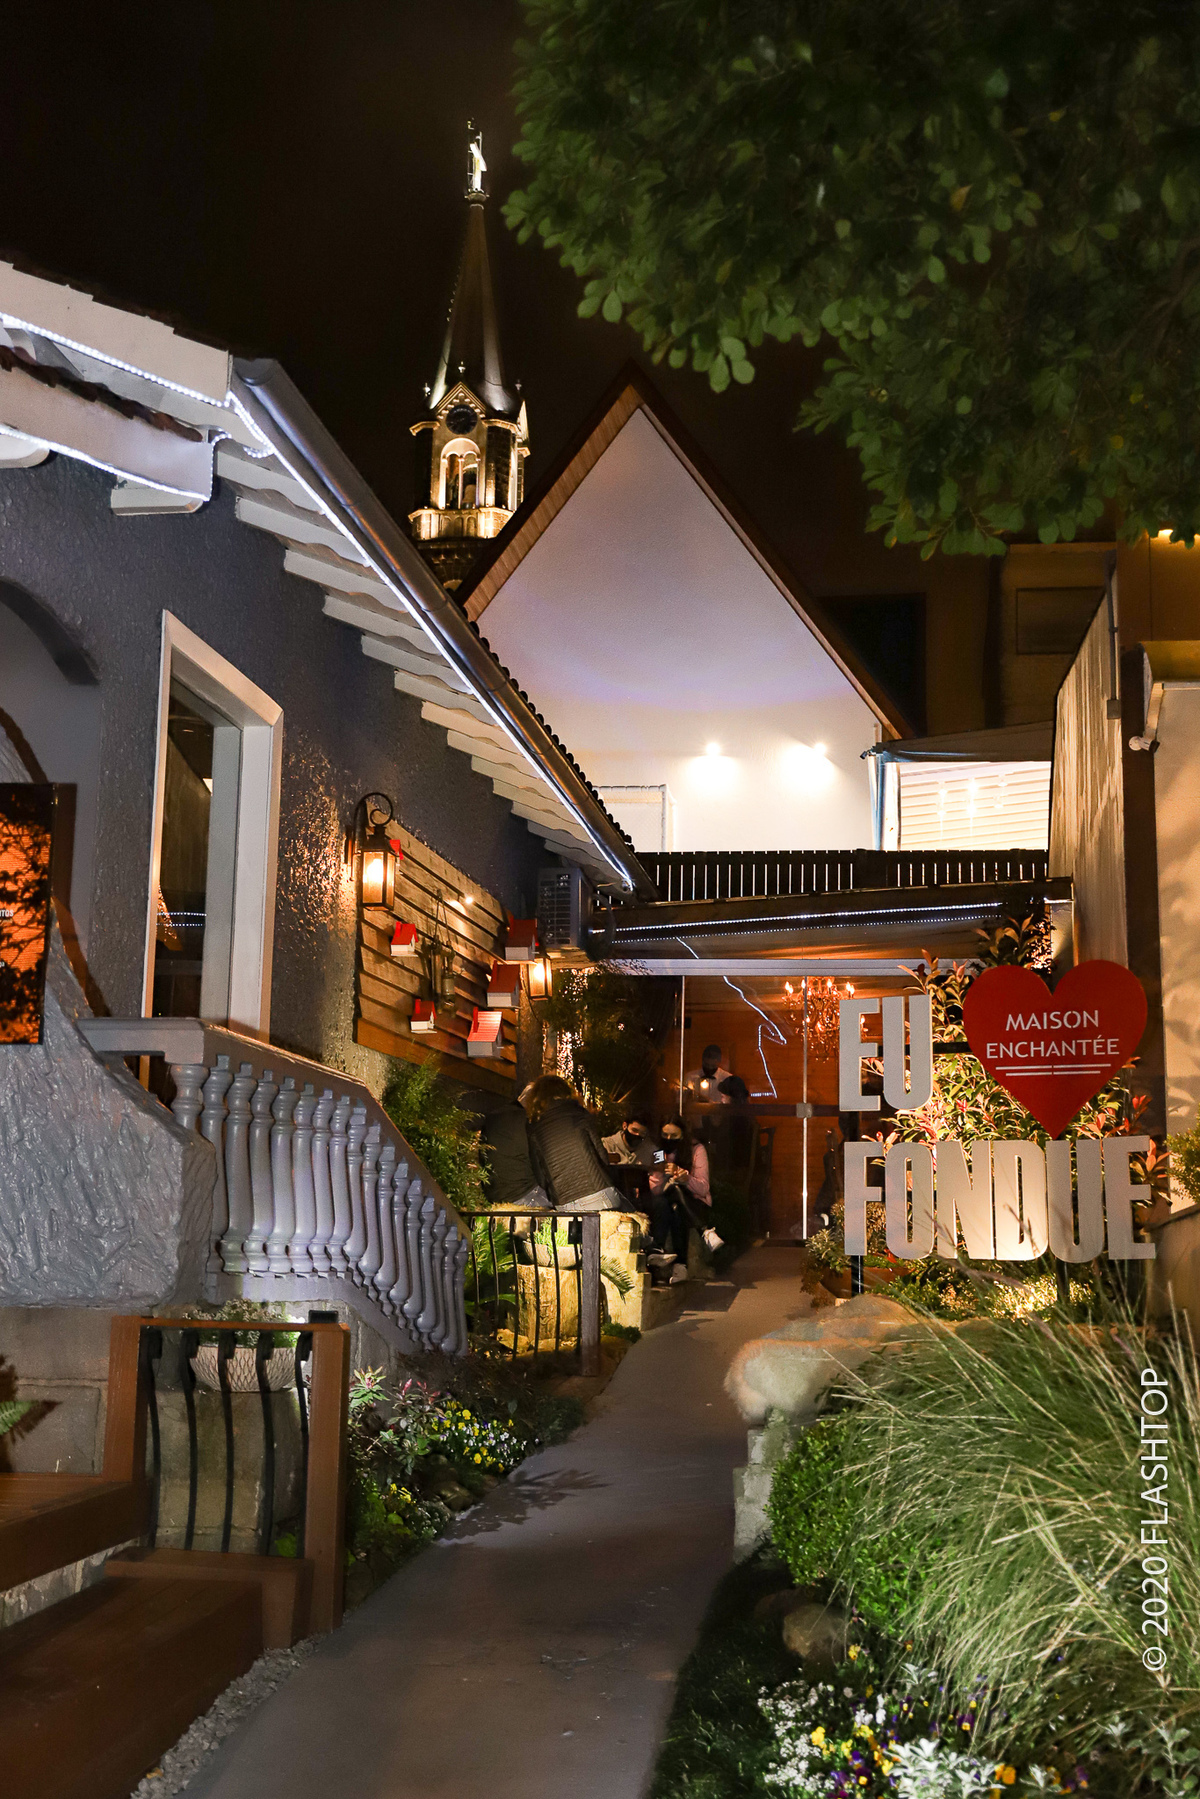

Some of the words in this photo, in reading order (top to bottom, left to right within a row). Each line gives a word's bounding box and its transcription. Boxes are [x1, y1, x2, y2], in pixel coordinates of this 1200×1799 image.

[839, 994, 932, 1112] EU
[986, 1035, 1120, 1059] ENCHANTÉE
[1005, 1010, 1099, 1032] MAISON
[844, 1135, 1156, 1263] FONDUE
